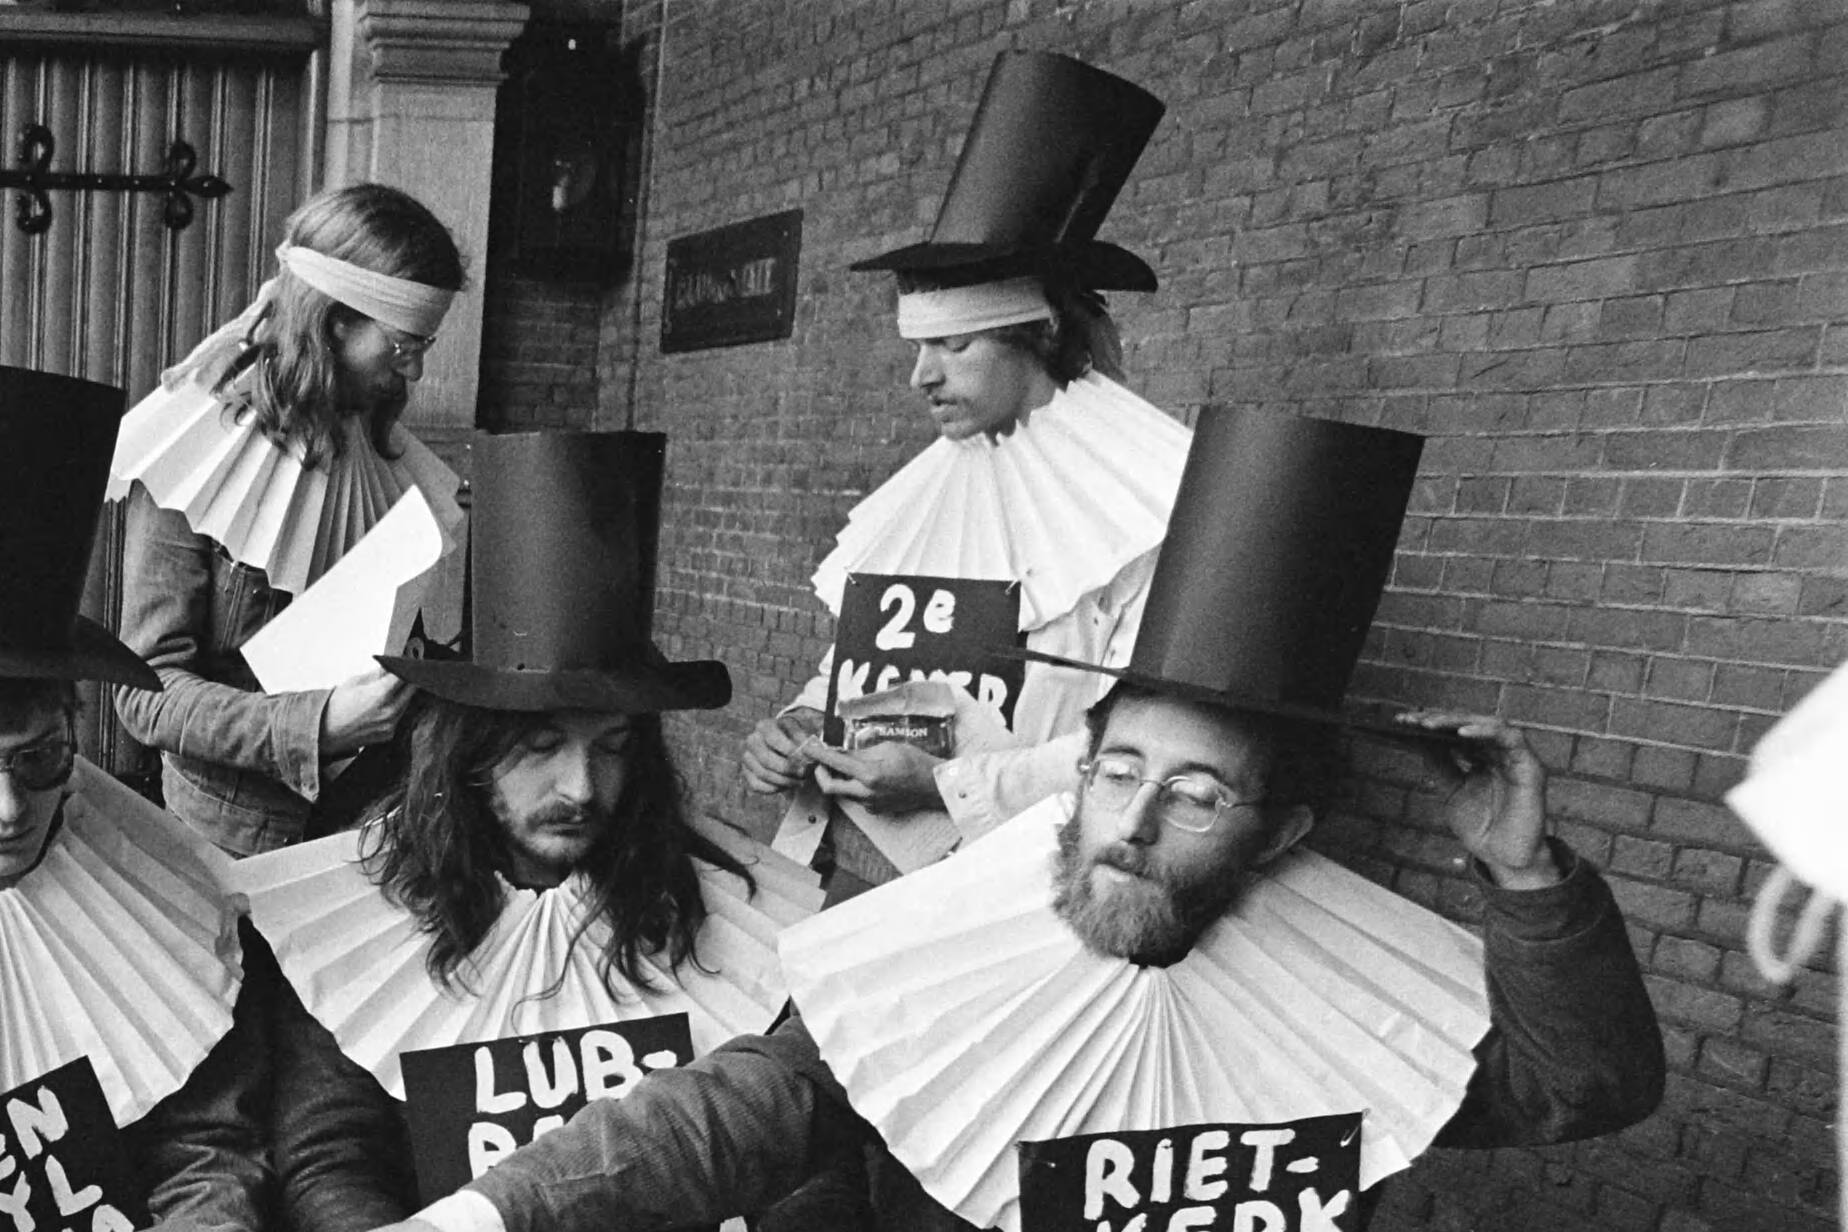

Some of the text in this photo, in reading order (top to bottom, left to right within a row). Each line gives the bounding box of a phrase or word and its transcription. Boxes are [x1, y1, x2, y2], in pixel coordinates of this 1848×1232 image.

[875, 583, 956, 651] 2e
[474, 1029, 678, 1114] LUB-
[1083, 1128, 1319, 1221] RIET-
